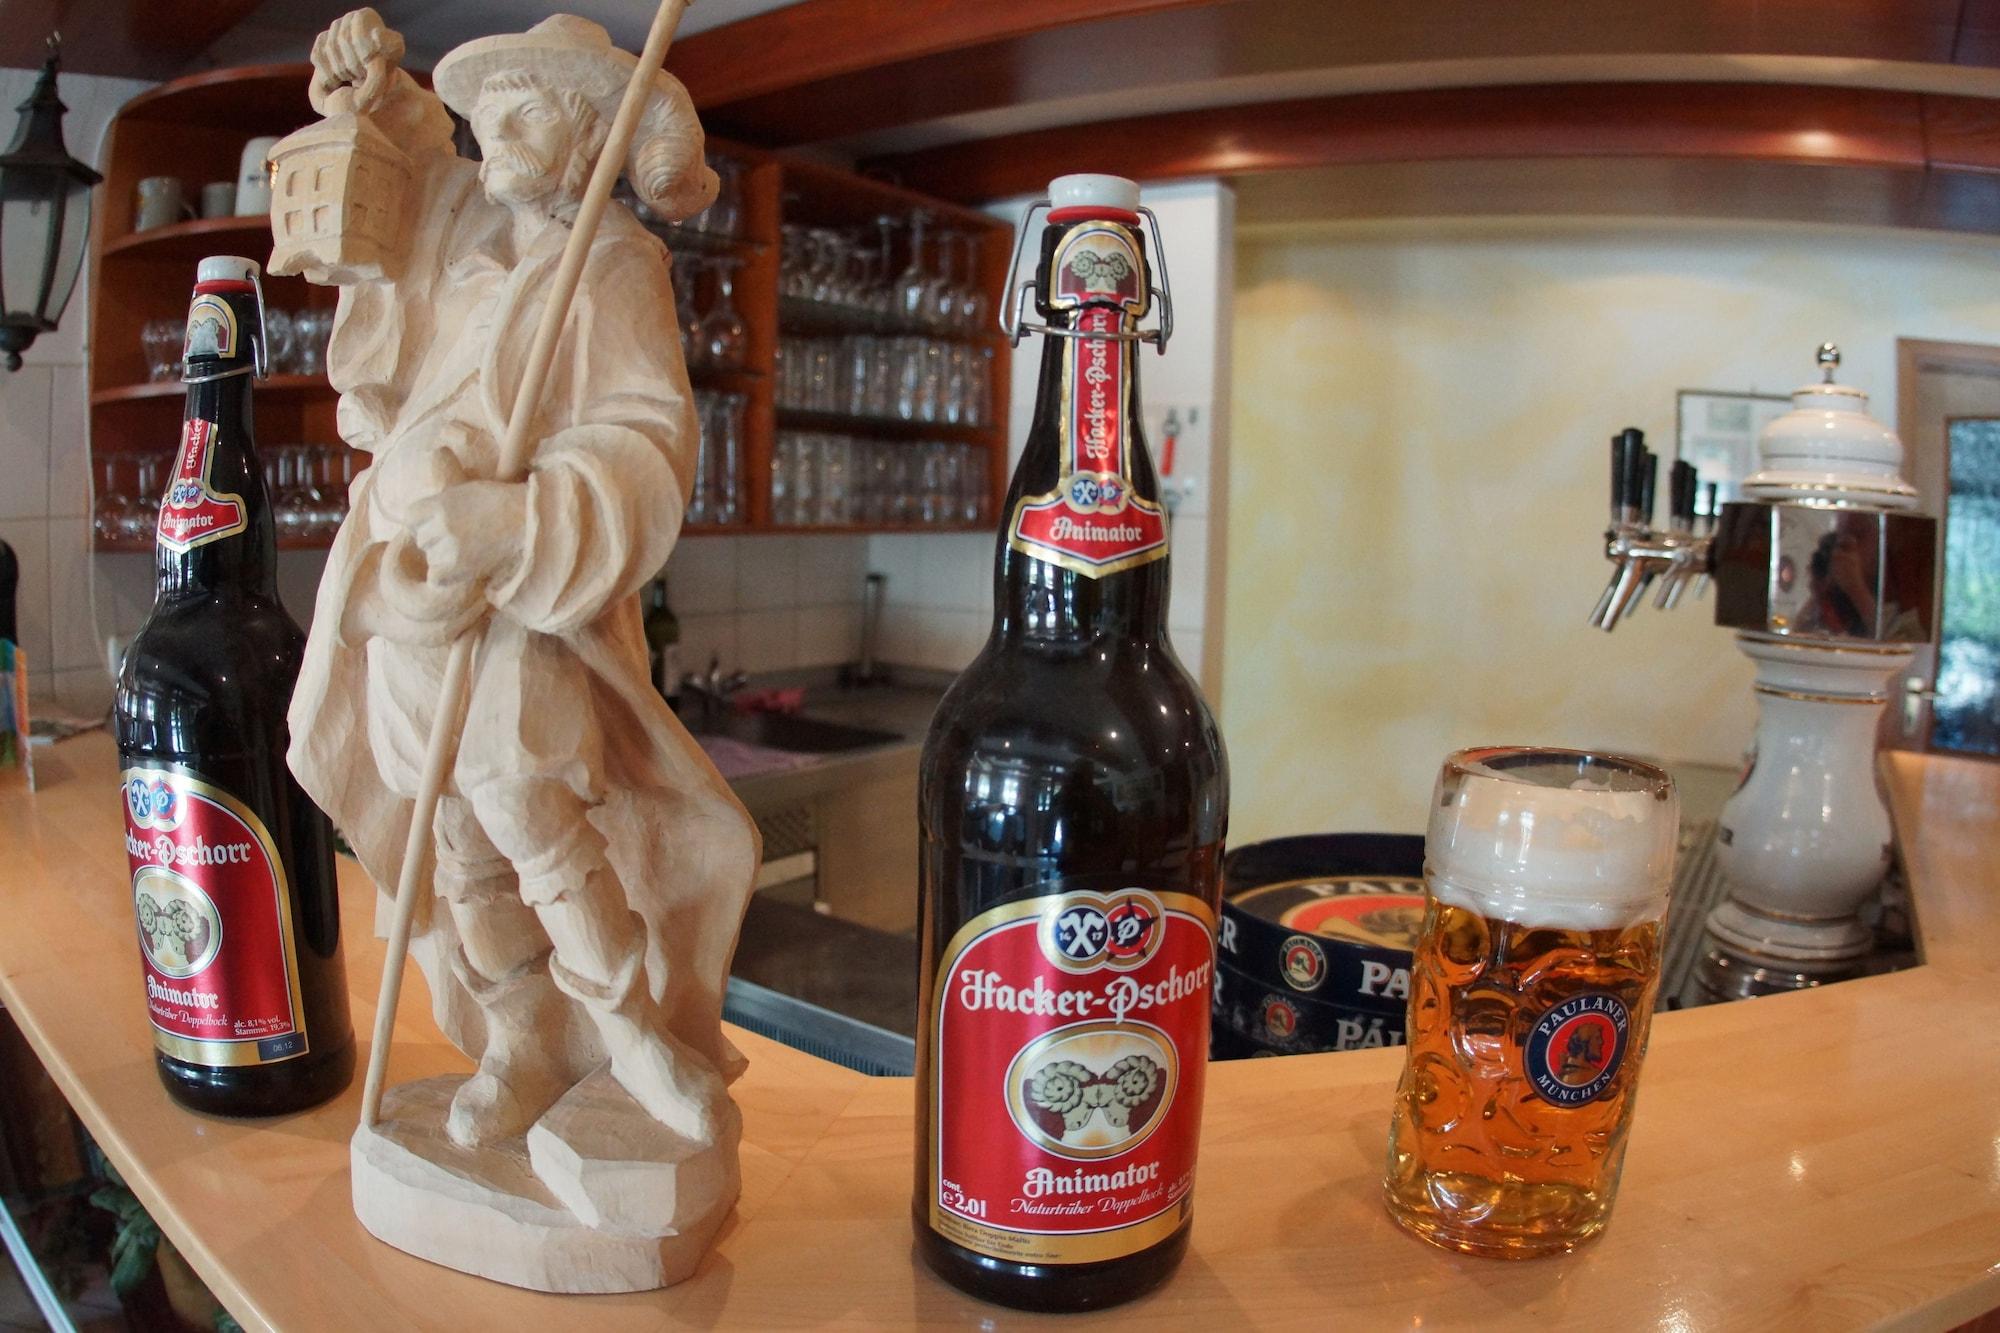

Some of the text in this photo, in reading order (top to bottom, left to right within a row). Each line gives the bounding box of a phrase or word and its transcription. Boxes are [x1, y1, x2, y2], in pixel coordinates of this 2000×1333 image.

[162, 512, 214, 529] Animator
[1049, 516, 1142, 542] Animator
[125, 827, 251, 870] cker-Pschorr
[1218, 915, 1237, 954] R
[147, 974, 219, 1009] Animator
[960, 960, 1210, 1024] Hacker-Pschorr
[178, 1010, 228, 1028] Doppelbock
[1538, 997, 1627, 1037] PAULANER
[943, 1179, 963, 1193] cont.
[1023, 1161, 1160, 1198] Animator
[1010, 1198, 1095, 1215] Naturtrüber
[1097, 1182, 1163, 1215] Doppelbock
